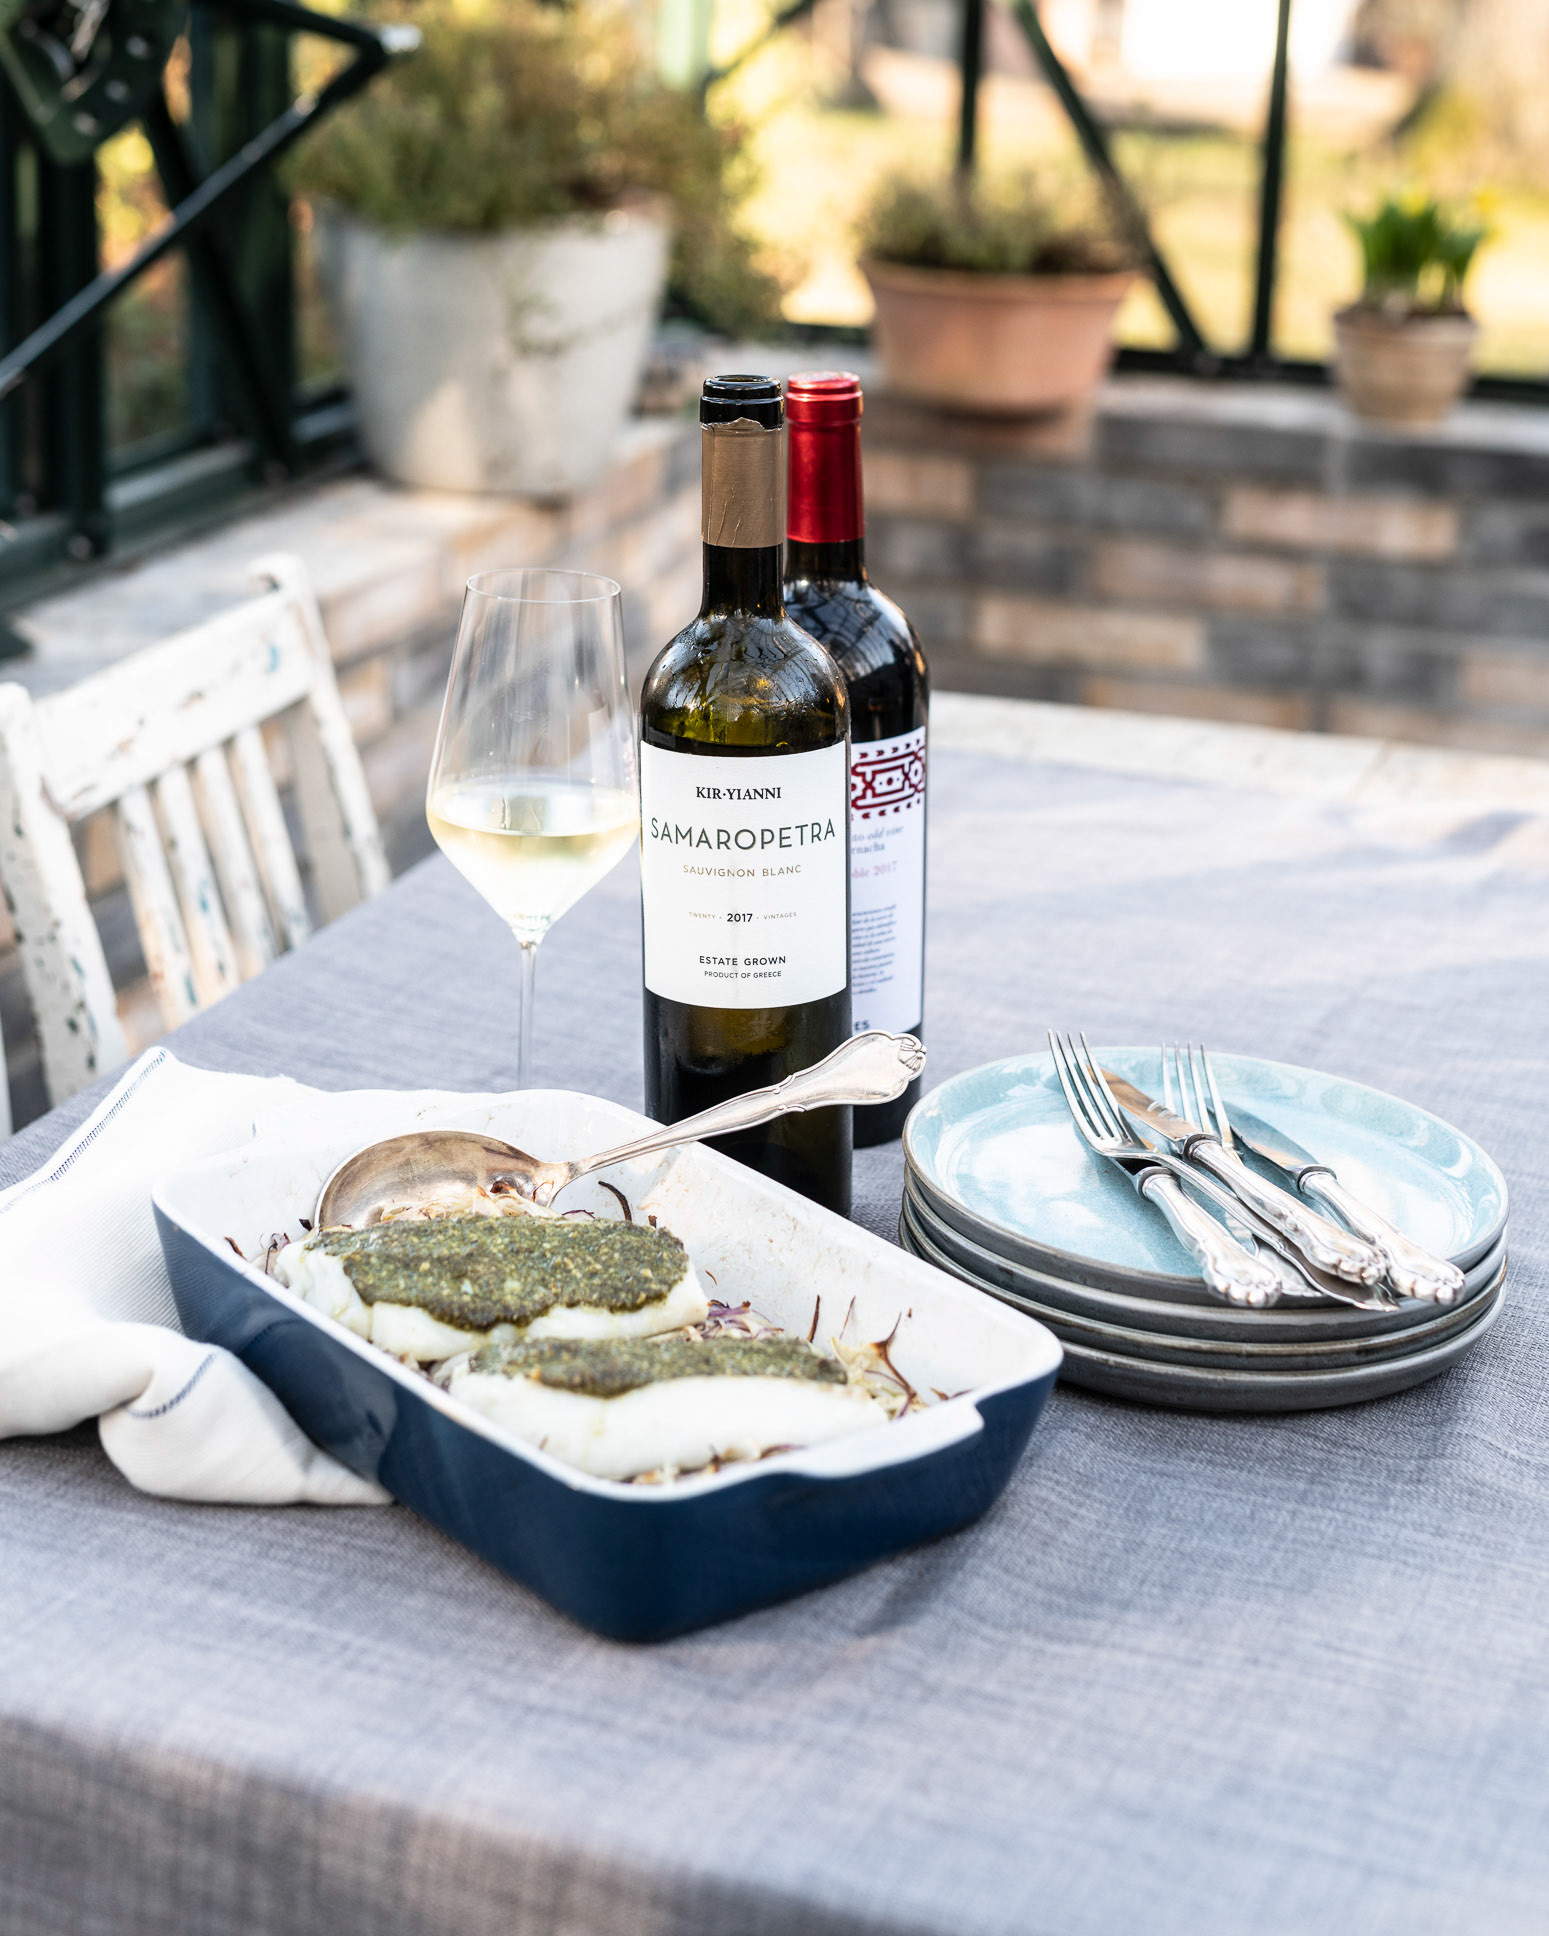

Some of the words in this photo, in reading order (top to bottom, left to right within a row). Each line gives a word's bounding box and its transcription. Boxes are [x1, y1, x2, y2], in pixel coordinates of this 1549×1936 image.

[651, 817, 836, 850] SAMAROPETRA
[683, 864, 755, 878] SAUVIGNON
[762, 864, 801, 877] BLANC
[688, 911, 716, 920] TWENTY
[726, 913, 753, 923] 2017
[763, 911, 797, 920] VINTAGES
[699, 955, 738, 966] ESTATE
[743, 955, 786, 966] GROWN
[704, 970, 739, 979] PRODUCT
[753, 970, 782, 979] GREECE
